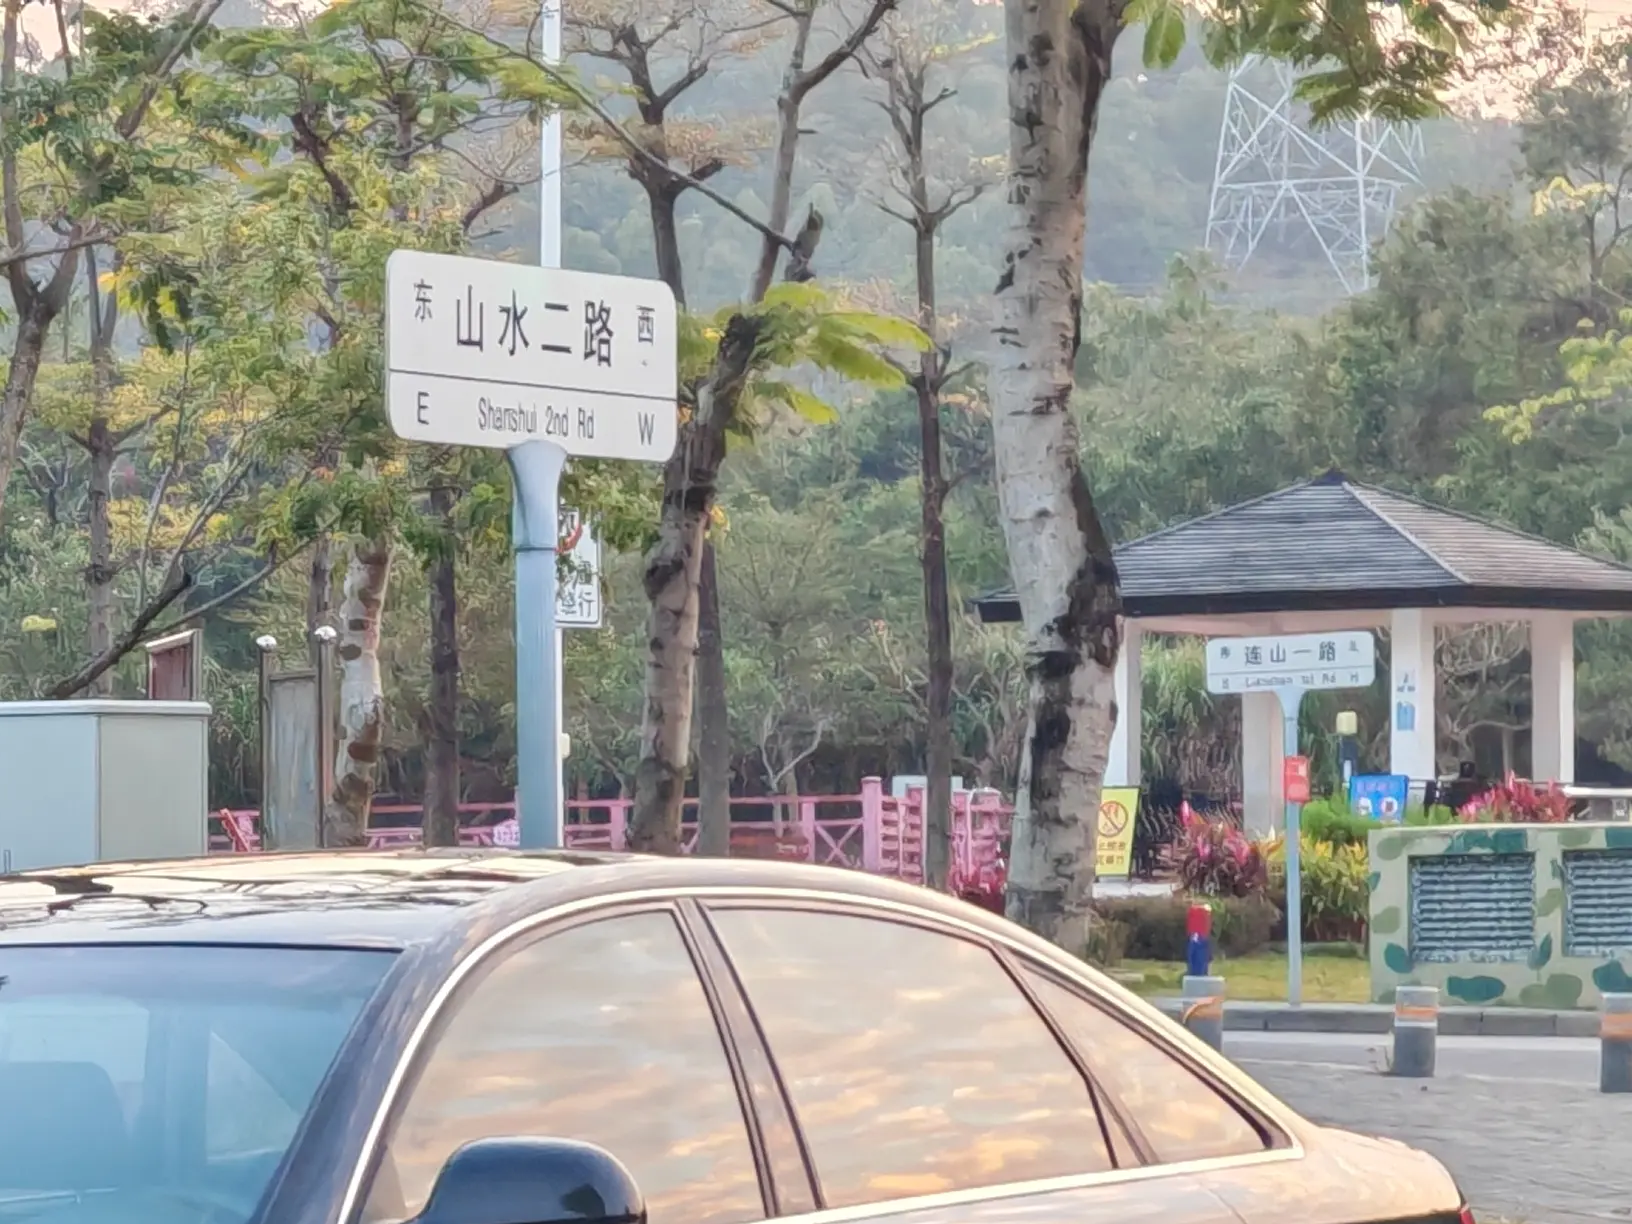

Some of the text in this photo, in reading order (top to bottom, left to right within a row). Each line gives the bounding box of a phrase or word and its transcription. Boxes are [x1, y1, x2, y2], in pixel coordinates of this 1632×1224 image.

[413, 279, 655, 367] 东 山水二路 西
[417, 391, 655, 445] E Shanshui 2nd Rd W
[1244, 641, 1336, 666] 连山一路
